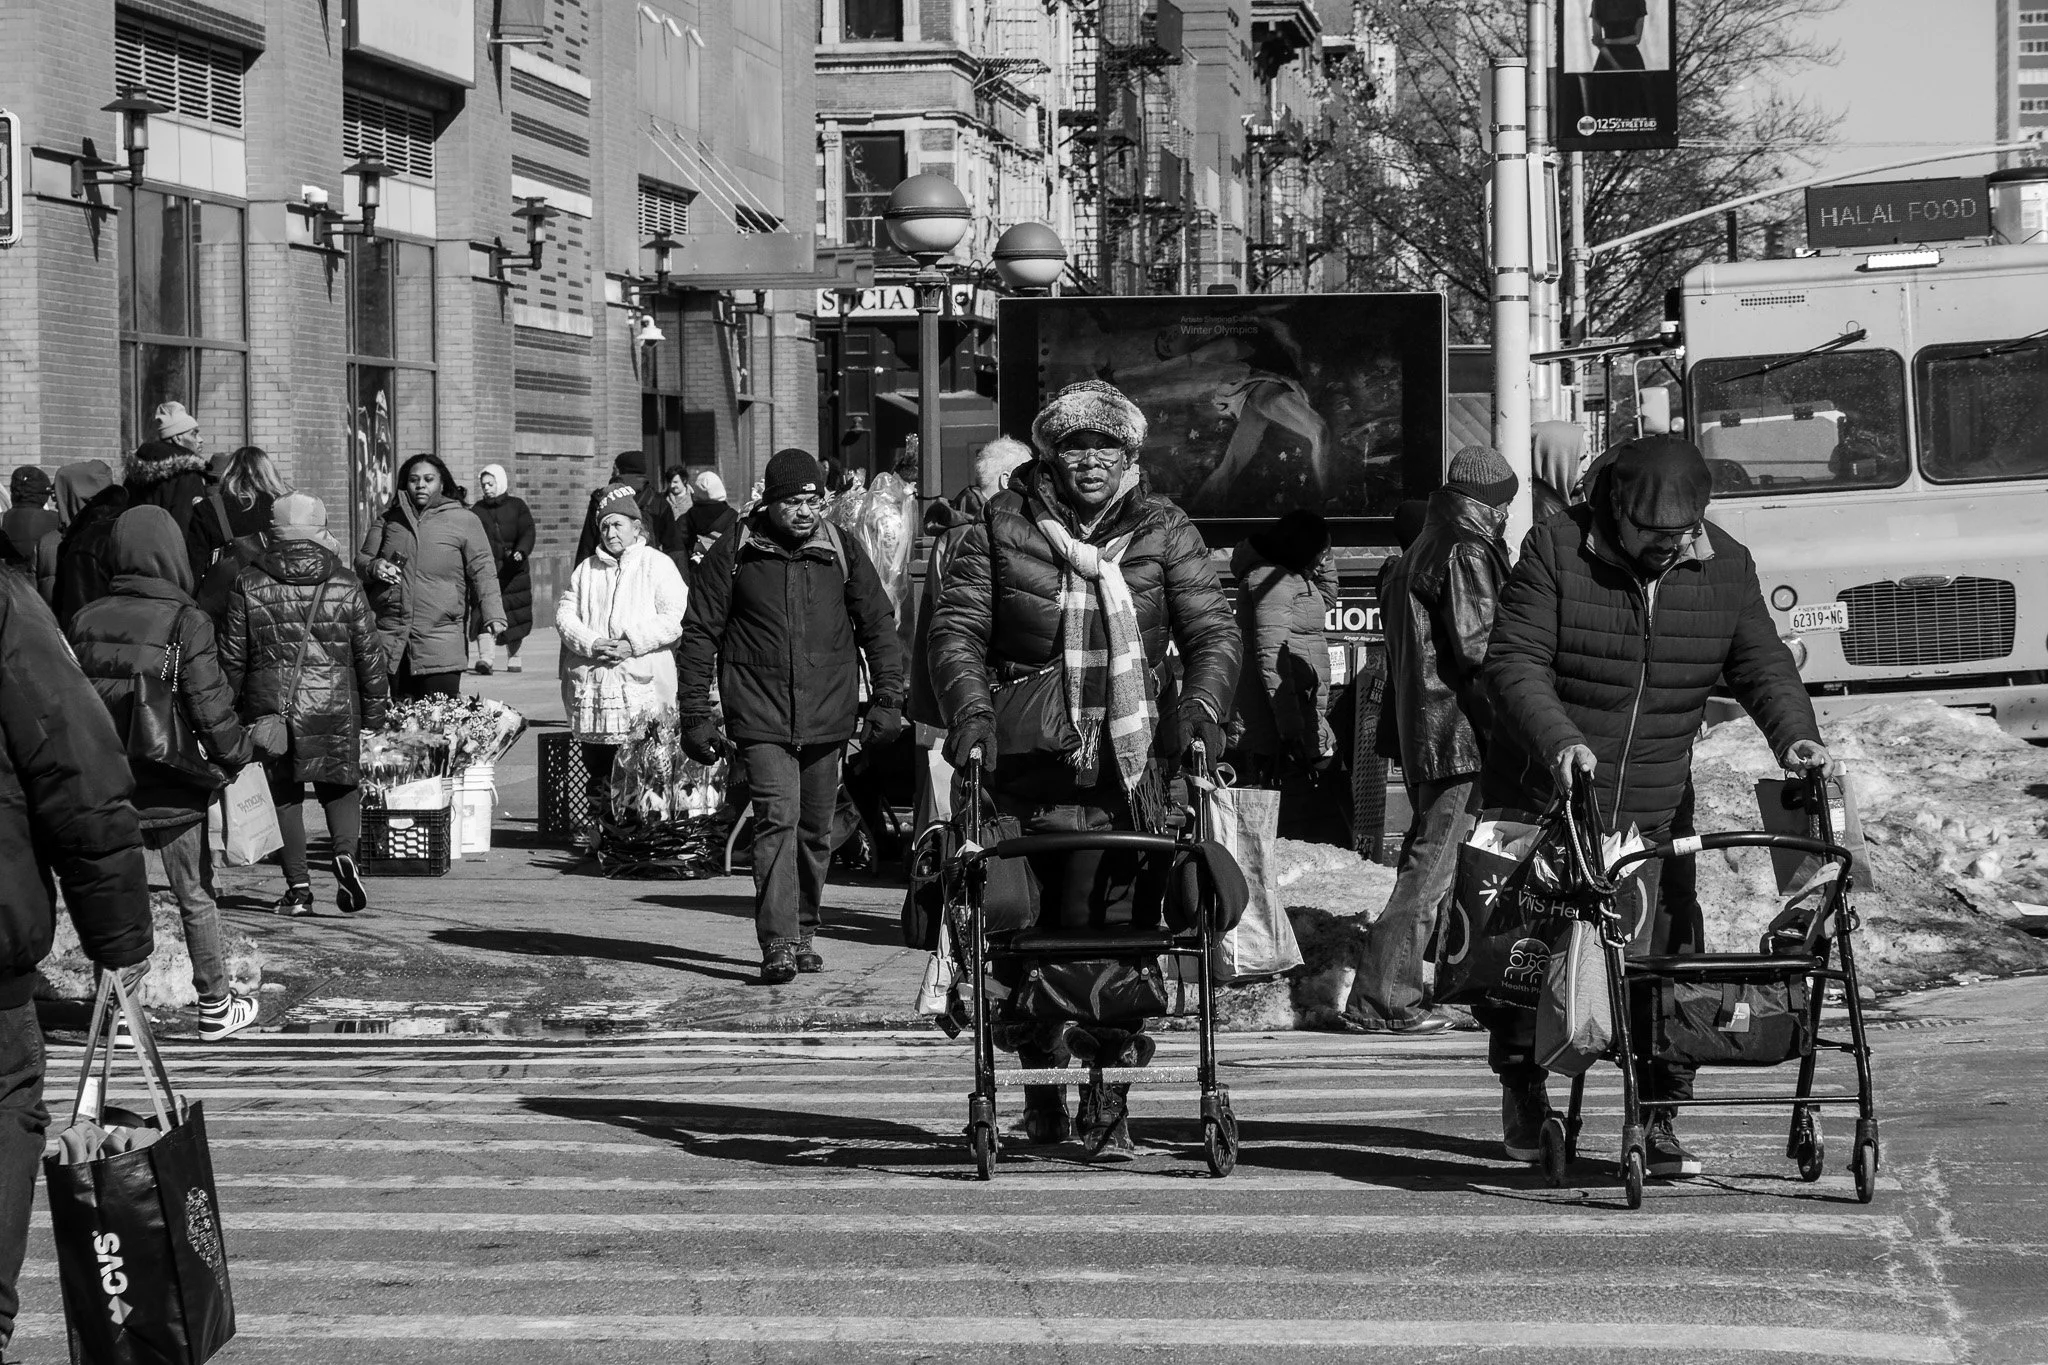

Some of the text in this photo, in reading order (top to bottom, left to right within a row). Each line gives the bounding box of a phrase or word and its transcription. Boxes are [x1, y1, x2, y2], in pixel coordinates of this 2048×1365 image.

[1820, 198, 1977, 228] HALAL FOOD
[822, 288, 918, 311] SCIA
[1180, 324, 1259, 336] Winter Olympics
[607, 485, 637, 501] YORK
[1518, 890, 1546, 913] VNS
[1501, 980, 1530, 993] Health
[93, 1232, 128, 1295] CVS
